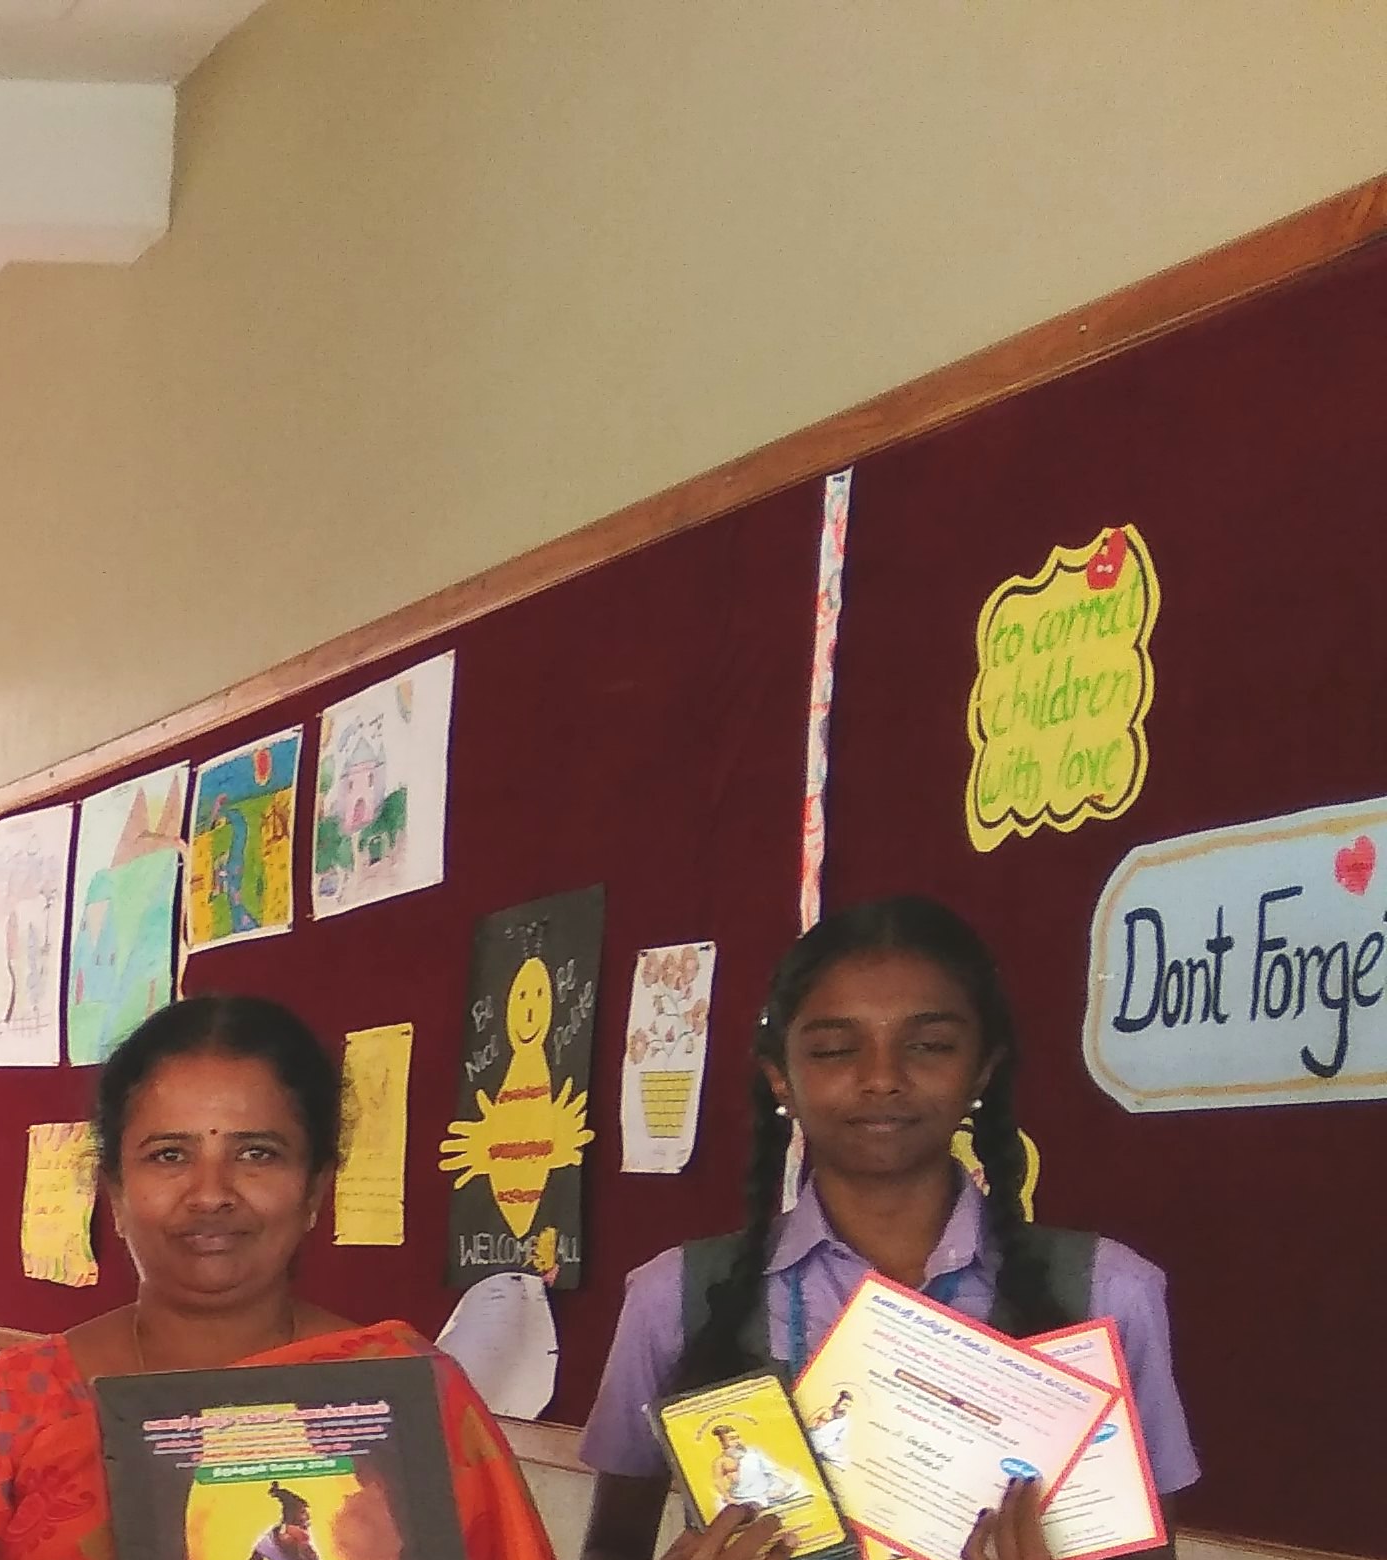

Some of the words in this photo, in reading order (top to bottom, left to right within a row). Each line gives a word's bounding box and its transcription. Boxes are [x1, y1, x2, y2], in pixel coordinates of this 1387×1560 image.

[993, 613, 1025, 667] to
[992, 656, 1132, 736] children
[981, 744, 1041, 807] with
[1058, 731, 1121, 790] love
[1113, 905, 1234, 1032] Dont
[1250, 885, 1387, 1077] Forge
